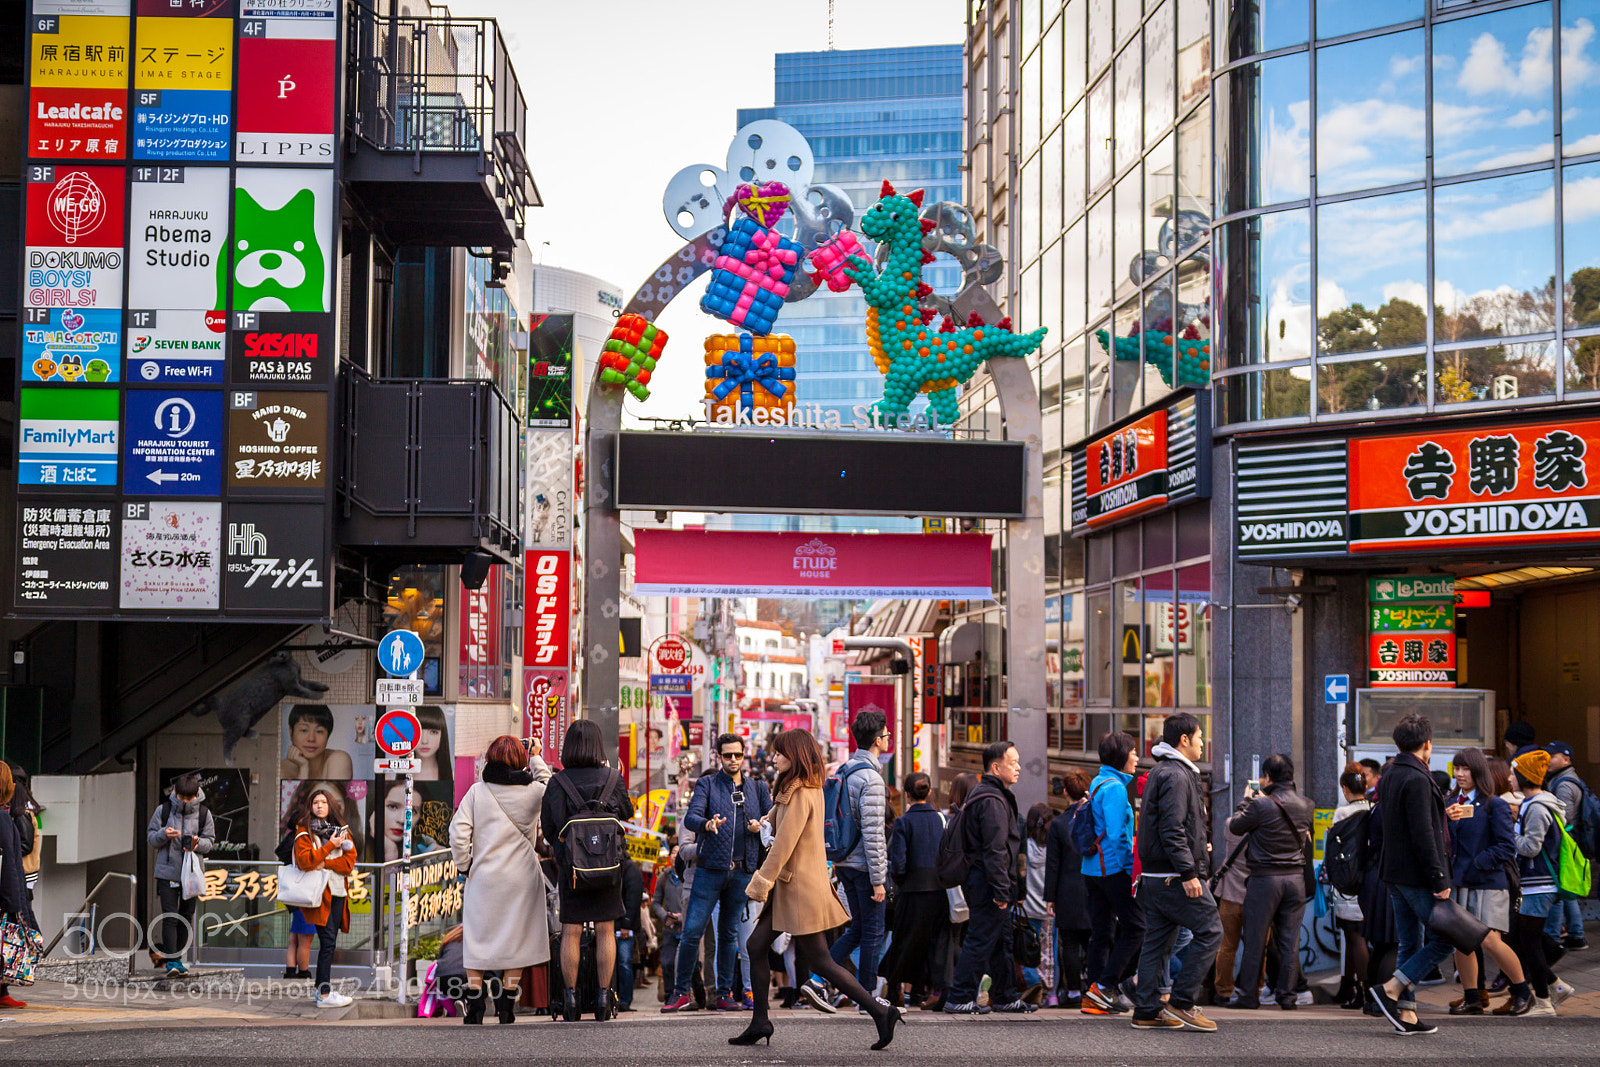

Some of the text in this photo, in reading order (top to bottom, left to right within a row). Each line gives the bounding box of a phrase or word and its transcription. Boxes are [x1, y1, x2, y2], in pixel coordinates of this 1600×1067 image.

[38, 20, 55, 31] 6F
[243, 22, 262, 36] 4F
[40, 45, 125, 62] 原宿駅前
[140, 47, 225, 63] ステージ
[40, 69, 124, 77] HARAJUKUEK
[140, 94, 157, 105] 5F
[37, 102, 123, 120] Leadcafe
[173, 126, 198, 134] Holdings
[37, 138, 119, 154] エリア原宿
[146, 149, 164, 157] Rising
[165, 149, 196, 157] production
[239, 141, 332, 156] LIPPS
[33, 167, 51, 181] 3F
[137, 168, 151, 181] 1F
[162, 168, 180, 181] 2F
[149, 210, 209, 221] HARAJUKU
[145, 225, 211, 243] Abema
[30, 251, 121, 269] DOKUMO
[146, 249, 210, 267] Studio
[29, 269, 91, 287] BOYS!
[29, 288, 97, 306] GIRLS!
[28, 308, 47, 322] 1F
[133, 312, 150, 326] 1F
[236, 313, 255, 328] 1F
[26, 331, 117, 344] TAMAGOTCHI
[154, 340, 189, 350] SEVEN
[191, 340, 221, 350] BANK
[244, 332, 318, 358] SASAKI
[164, 365, 212, 376] Free Wi-Fi
[250, 361, 312, 373] PAS à PAS
[234, 392, 253, 407] BF
[252, 405, 307, 420] HAND DRIP
[699, 398, 941, 432] Takeshita Street
[23, 428, 115, 447] FamilyMart
[137, 439, 210, 448] HARAJUKU TOURIST
[132, 447, 215, 456] INFORMATION CENTER
[239, 445, 318, 454] HOSHINO COFFEE
[1099, 428, 1138, 487] 吉野家
[234, 459, 322, 480] 星乃珈琲
[1402, 430, 1588, 502] 吉野家
[40, 465, 97, 483] 酒 たばこ
[180, 472, 201, 482] 20m
[1168, 465, 1196, 489] YOSHINOYA
[556, 490, 567, 514] CAT
[1100, 481, 1138, 513] YOSHINOYA
[23, 507, 111, 523] 防災備蓄倉庫
[127, 503, 145, 518] BF
[1403, 500, 1589, 537] YOSHINOYA
[1240, 519, 1344, 542] YOSHINOYA
[22, 538, 110, 551] Emergency Evacuation Area
[130, 550, 211, 568] さくら水産
[793, 556, 838, 569] ETUDE
[244, 558, 324, 588] アッシュ
[800, 570, 830, 578] HOUSE
[535, 555, 559, 663] OSドラッグ
[1390, 606, 1447, 620] ビリヤード
[1399, 618, 1437, 629] ダーツ
[658, 649, 684, 661] 消火栓
[1378, 639, 1449, 665] 吉野家
[1378, 670, 1449, 681] YOSHINOYA
[379, 682, 421, 692] 自転車を除く
[381, 693, 391, 702] 11
[408, 693, 418, 703] 18
[396, 866, 423, 891] HND
[422, 862, 443, 886] DRIP
